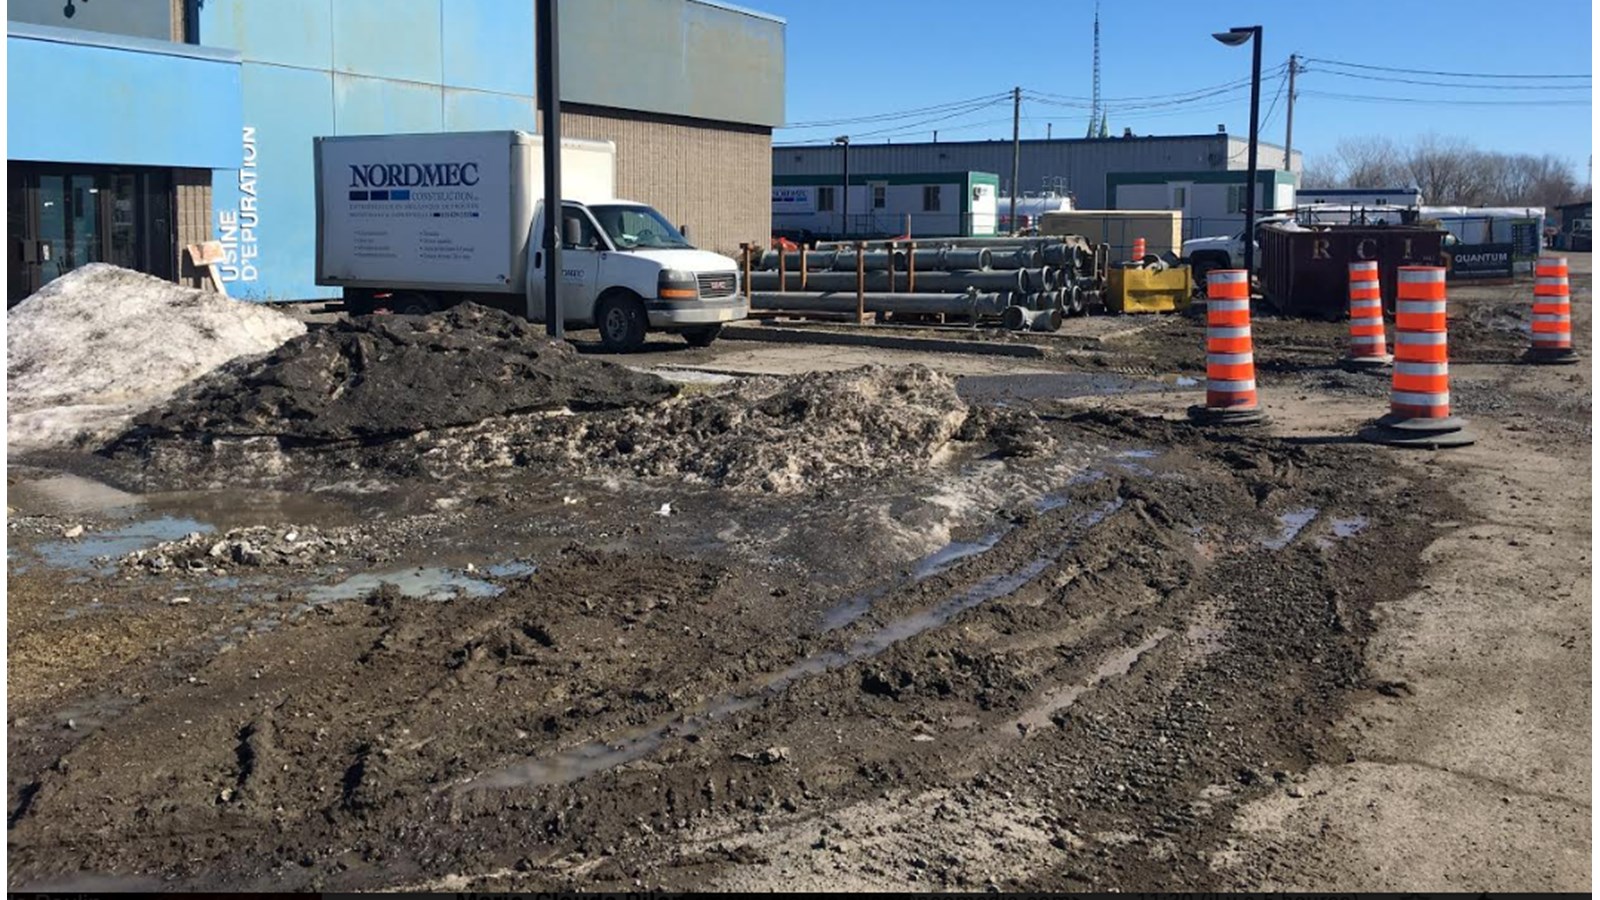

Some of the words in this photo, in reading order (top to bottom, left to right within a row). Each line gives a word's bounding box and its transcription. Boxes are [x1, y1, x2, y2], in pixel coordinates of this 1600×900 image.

[348, 162, 480, 188] NORDMEC
[411, 190, 474, 201] CONSTRUCTION
[219, 211, 239, 281] USINE
[1454, 252, 1508, 263] QUANTUM
